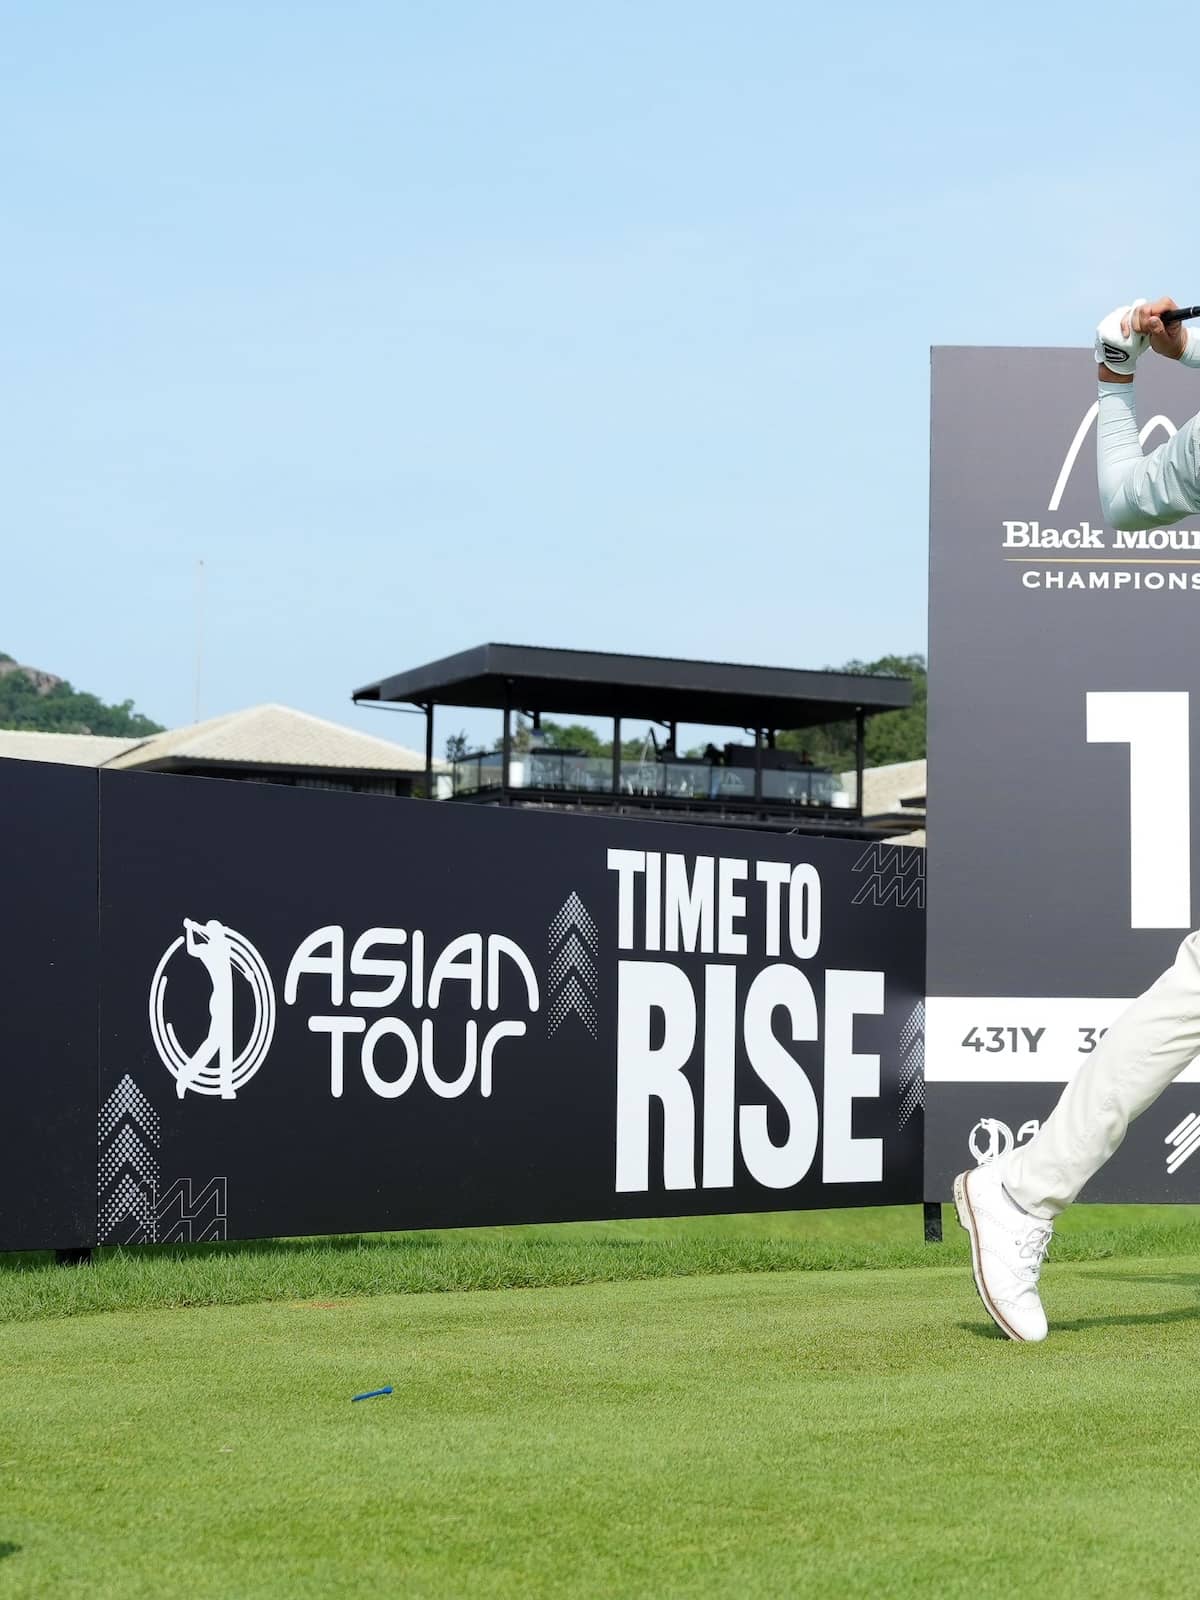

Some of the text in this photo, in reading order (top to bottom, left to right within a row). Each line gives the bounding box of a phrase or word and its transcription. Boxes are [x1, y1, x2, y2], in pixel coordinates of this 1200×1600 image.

[1002, 521, 1105, 549] Black
[1085, 691, 1191, 930] 1
[607, 848, 822, 960] TIME TO
[284, 925, 540, 1012] ASIAN
[308, 1016, 528, 1099] TOUR
[615, 960, 885, 1193] RISE
[961, 1026, 1046, 1053] 431Y
